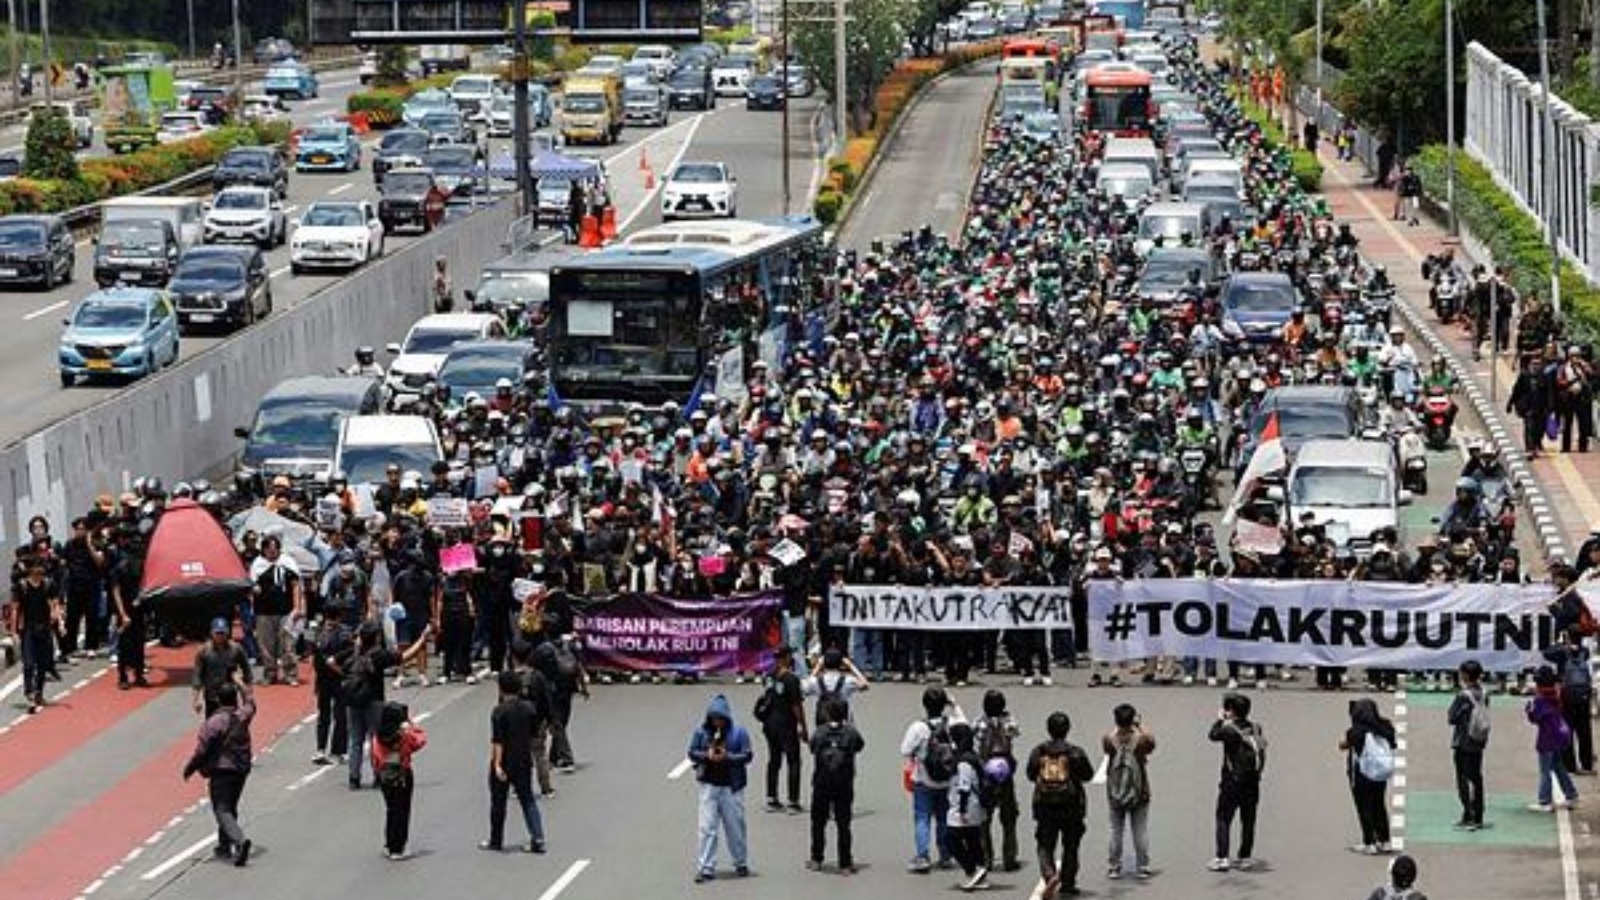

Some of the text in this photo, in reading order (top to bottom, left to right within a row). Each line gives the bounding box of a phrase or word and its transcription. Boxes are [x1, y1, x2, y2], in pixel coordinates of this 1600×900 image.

[834, 592, 876, 621] TNI
[880, 593, 965, 623] TAKUT
[1105, 600, 1552, 651] #TOLAKRUUTNI
[672, 637, 707, 652] RUU
[711, 636, 739, 651] TNI
